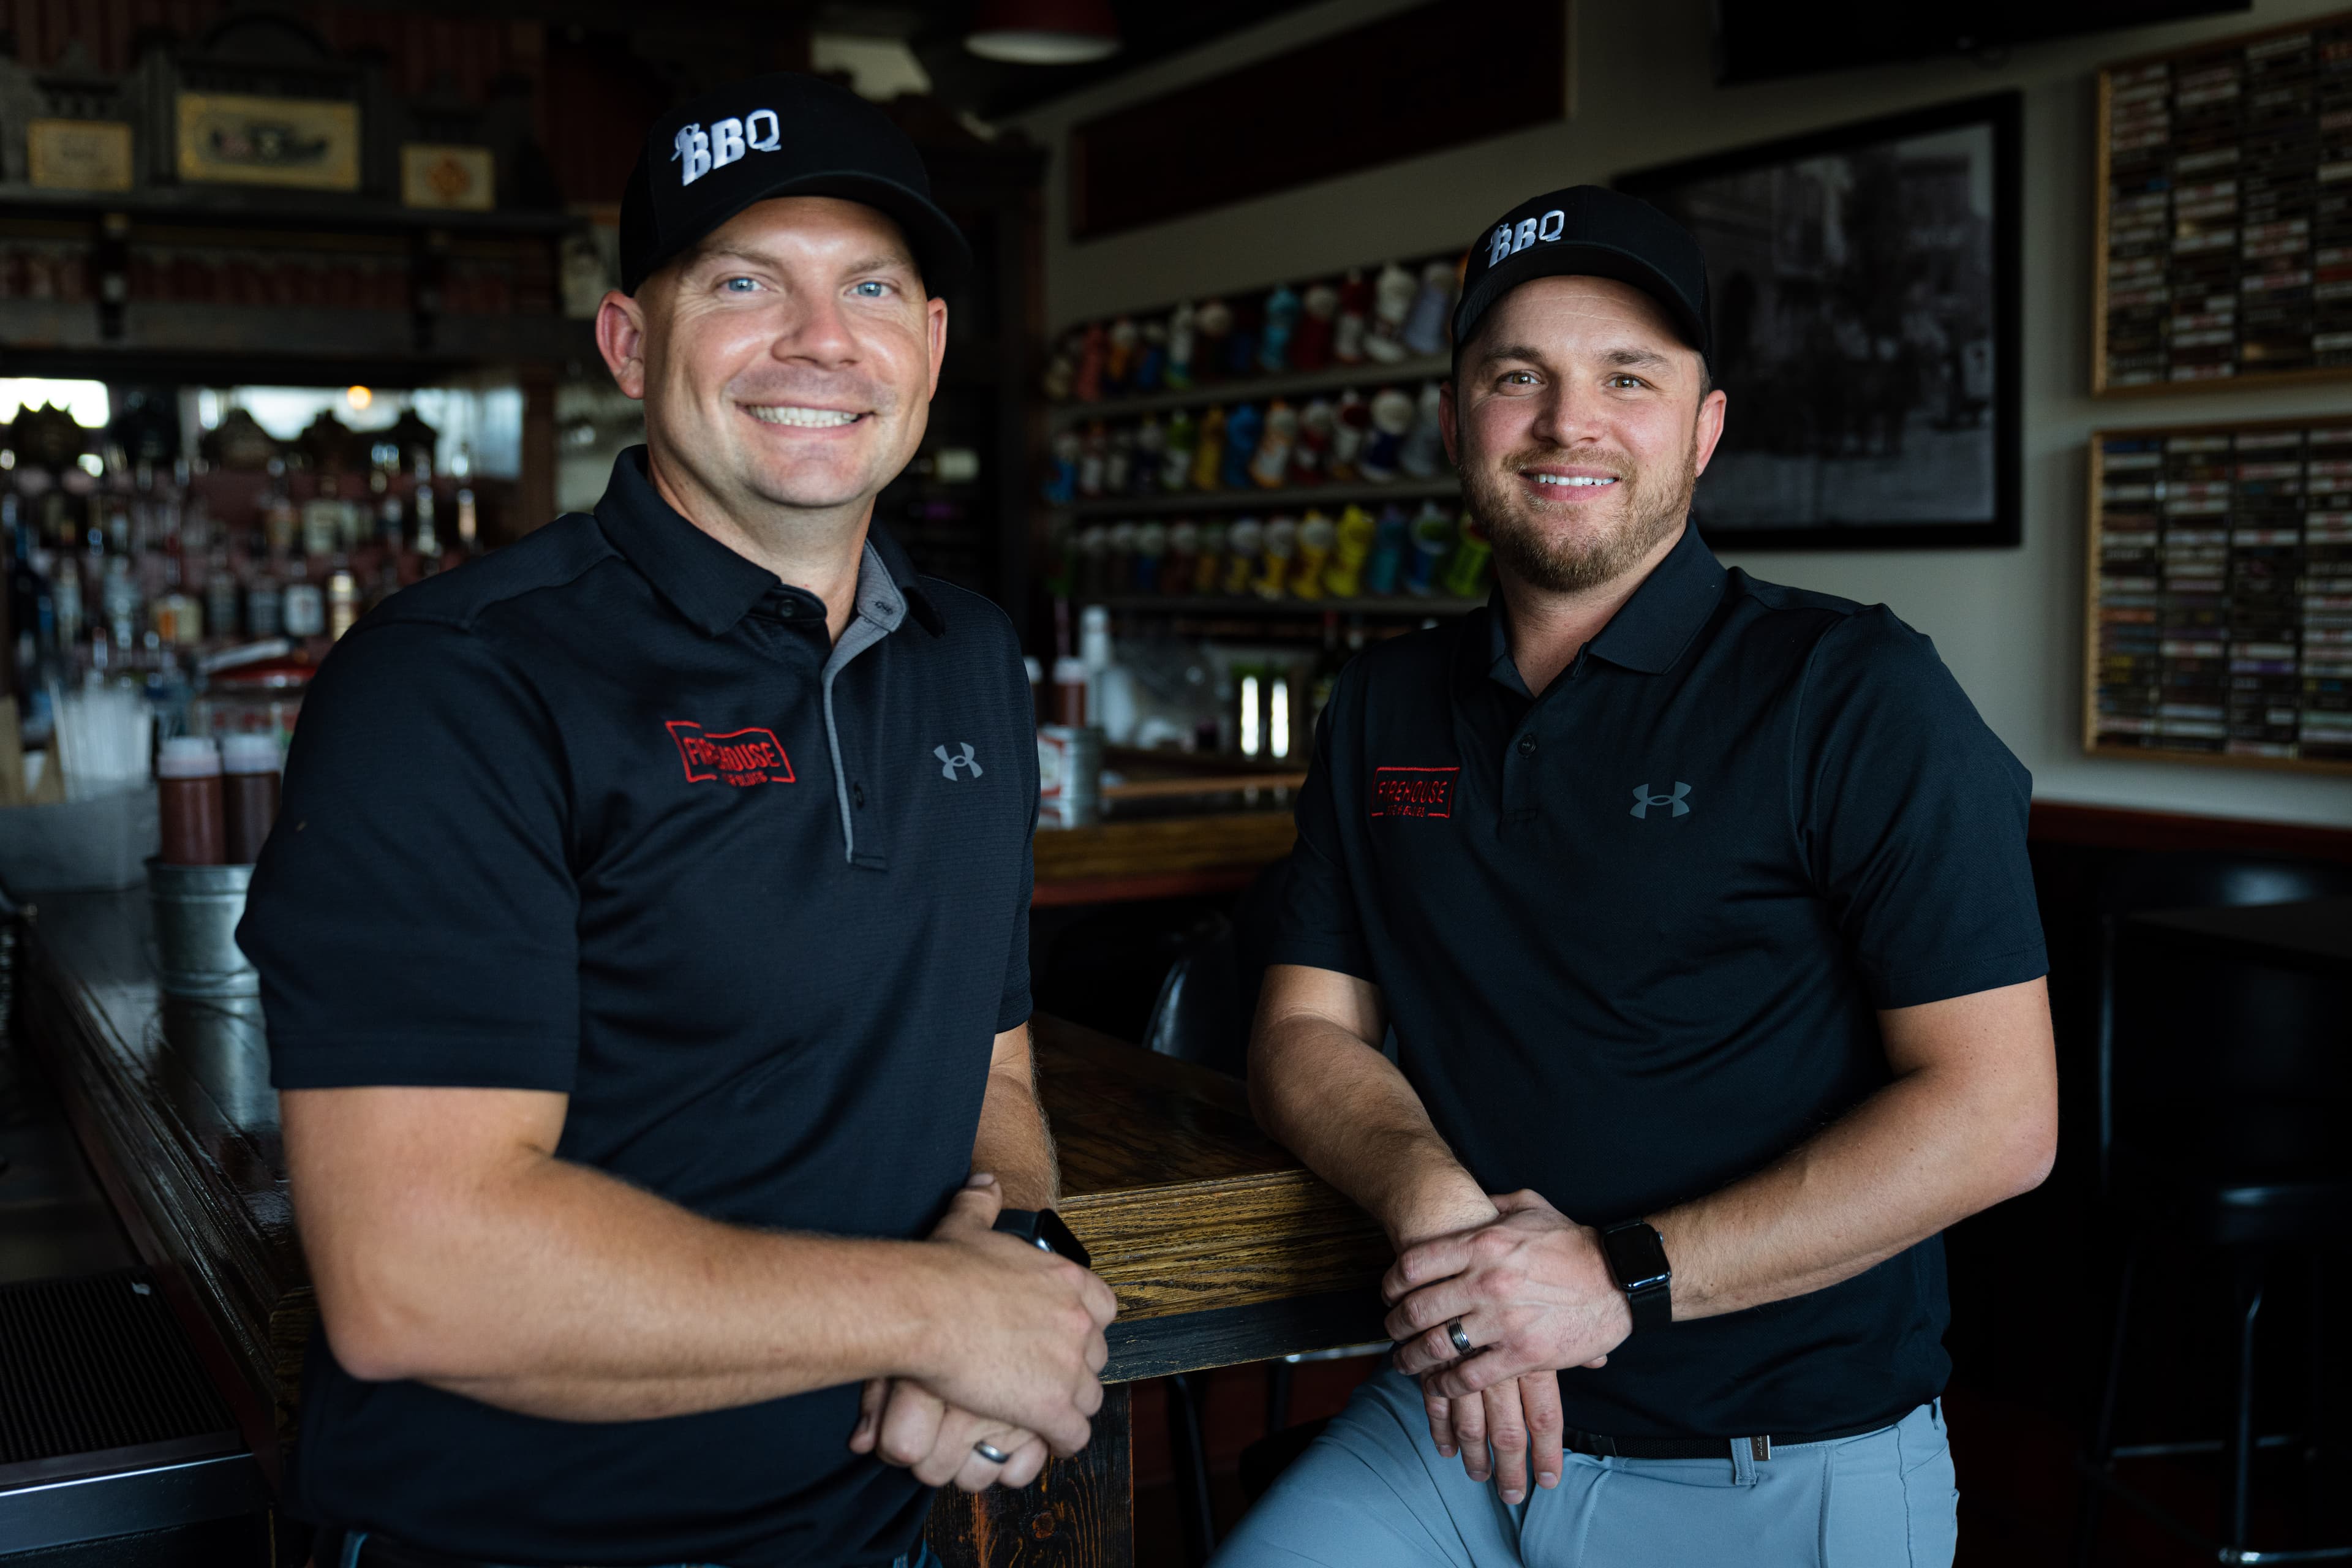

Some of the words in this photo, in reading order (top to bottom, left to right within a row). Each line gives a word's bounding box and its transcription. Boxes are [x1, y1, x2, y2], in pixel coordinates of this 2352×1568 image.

[672, 108, 782, 186] BBQ
[1485, 209, 1565, 268] BBQ
[1378, 780, 1447, 804] FIREHOUSE
